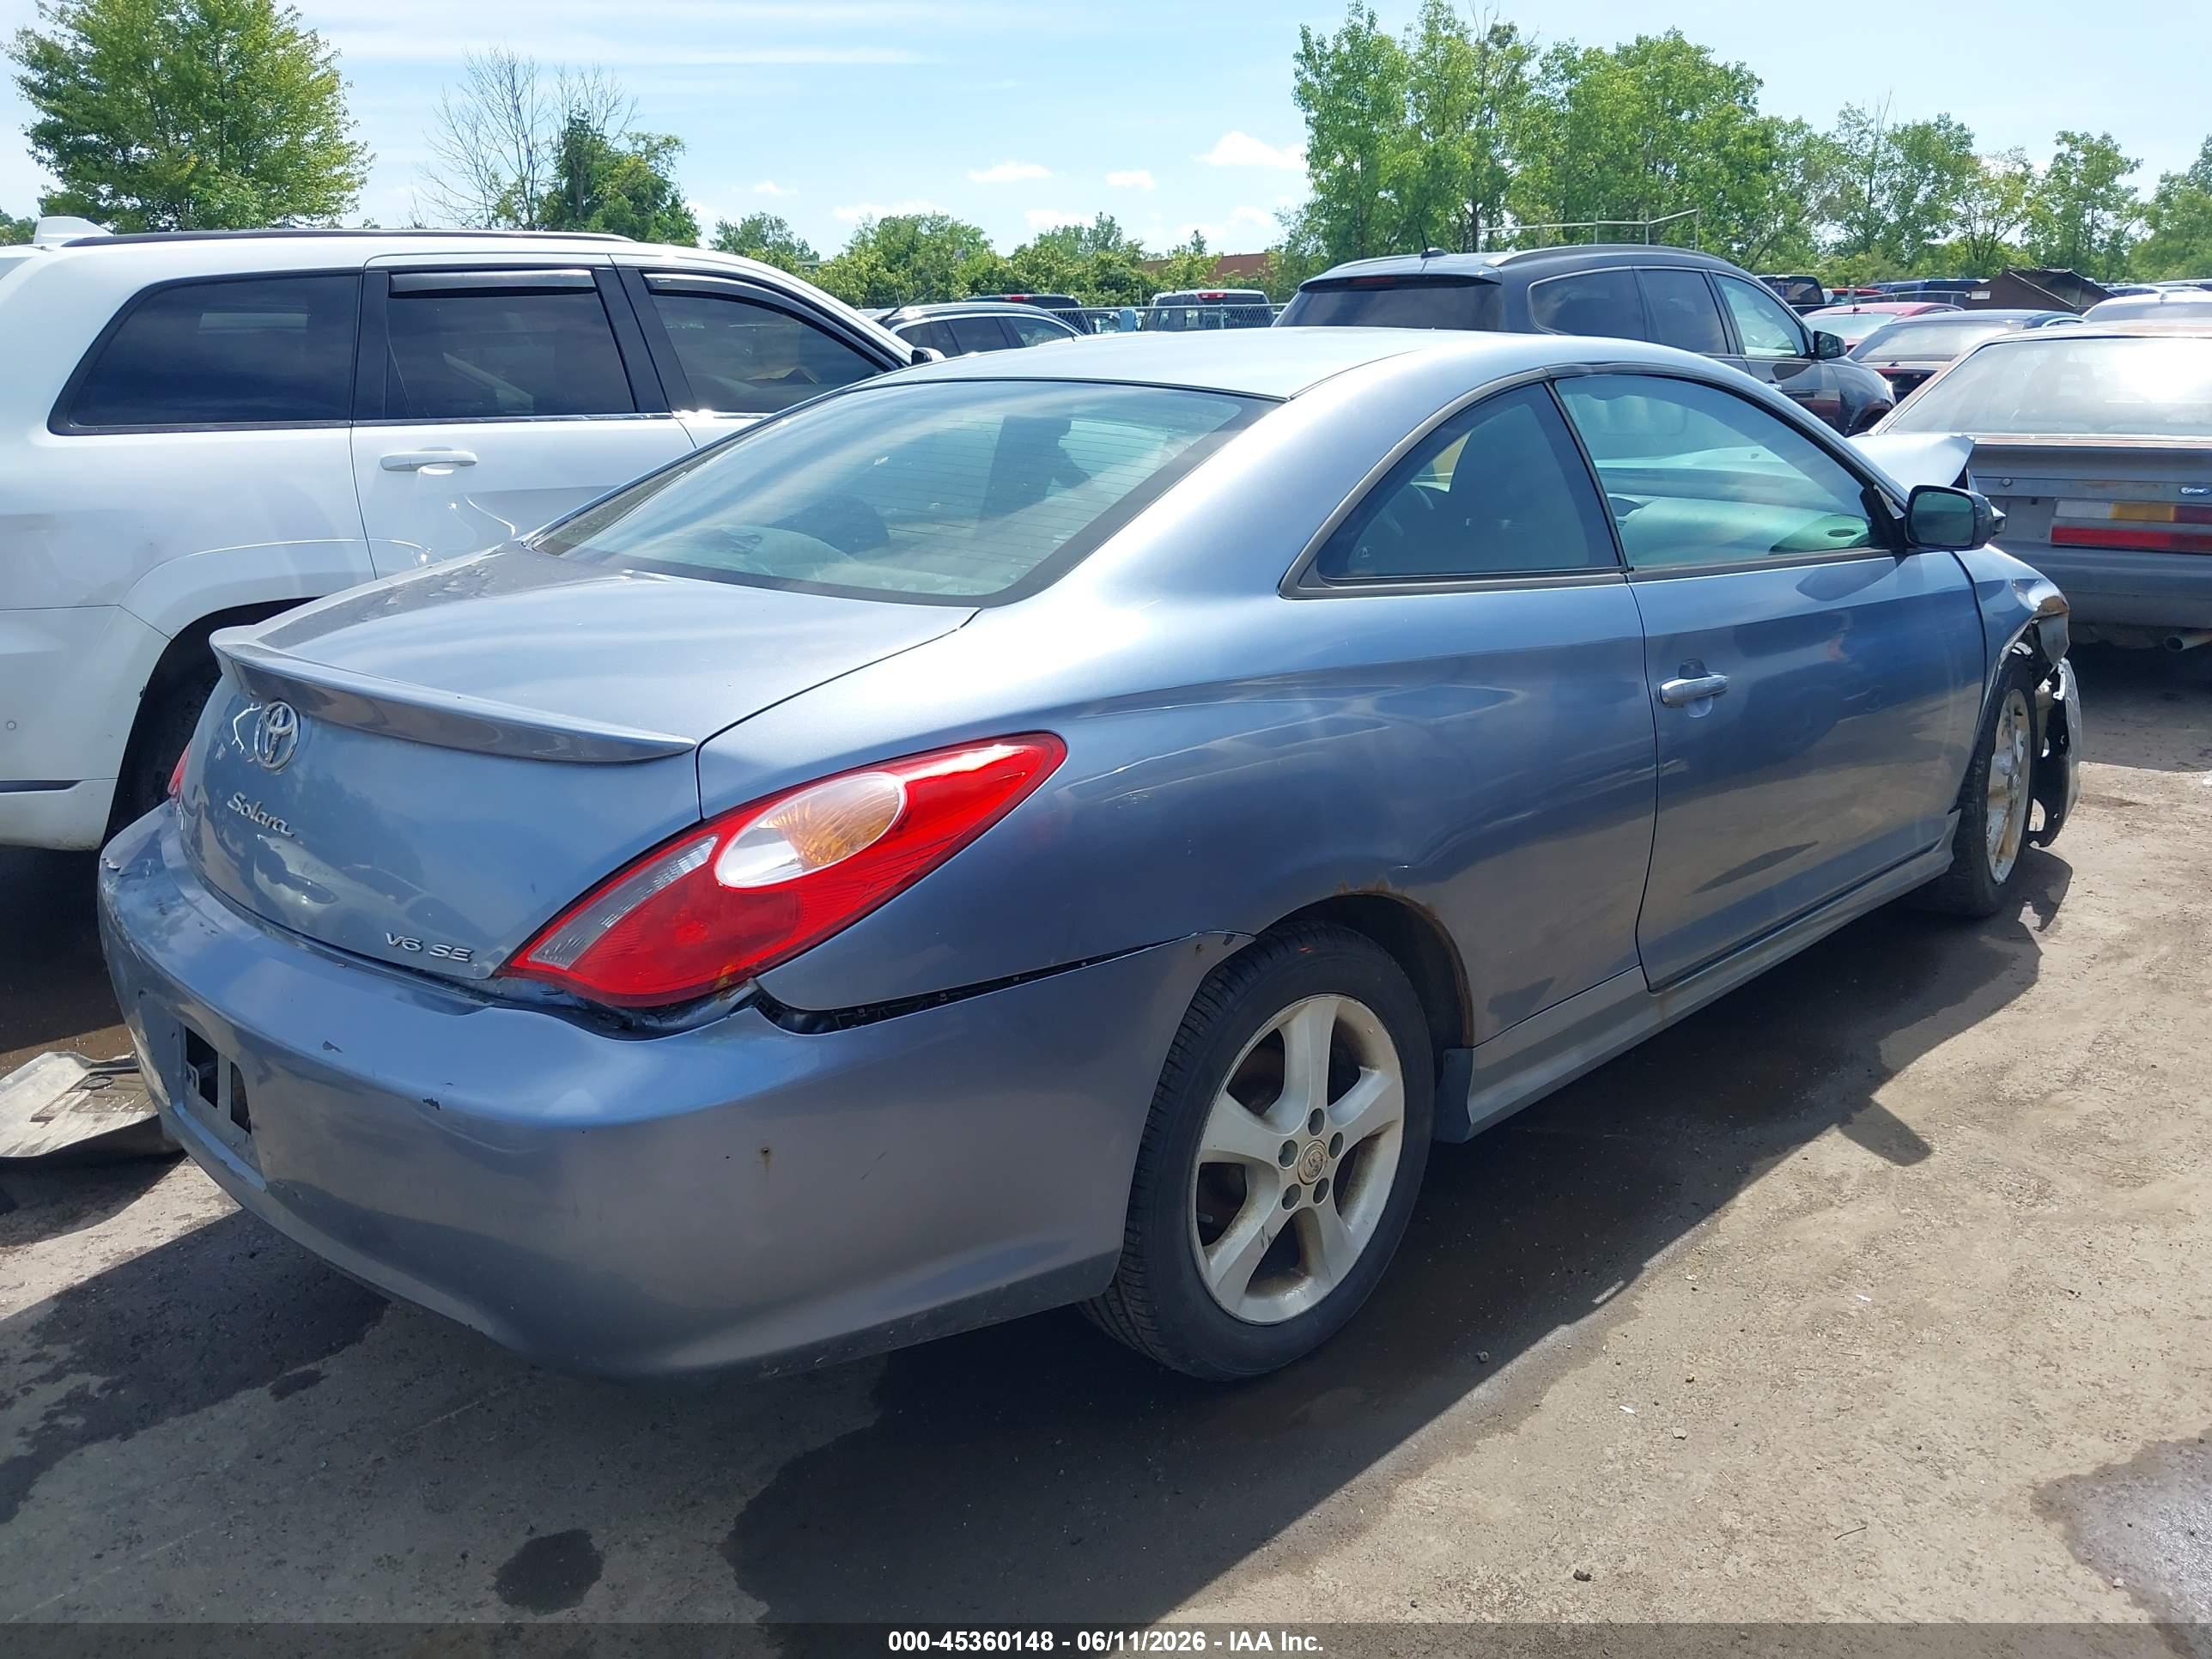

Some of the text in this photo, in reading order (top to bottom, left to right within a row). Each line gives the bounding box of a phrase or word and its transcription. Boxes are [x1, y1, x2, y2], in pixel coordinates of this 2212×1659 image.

[227, 791, 295, 837] Solara
[386, 933, 474, 962] V6 SE
